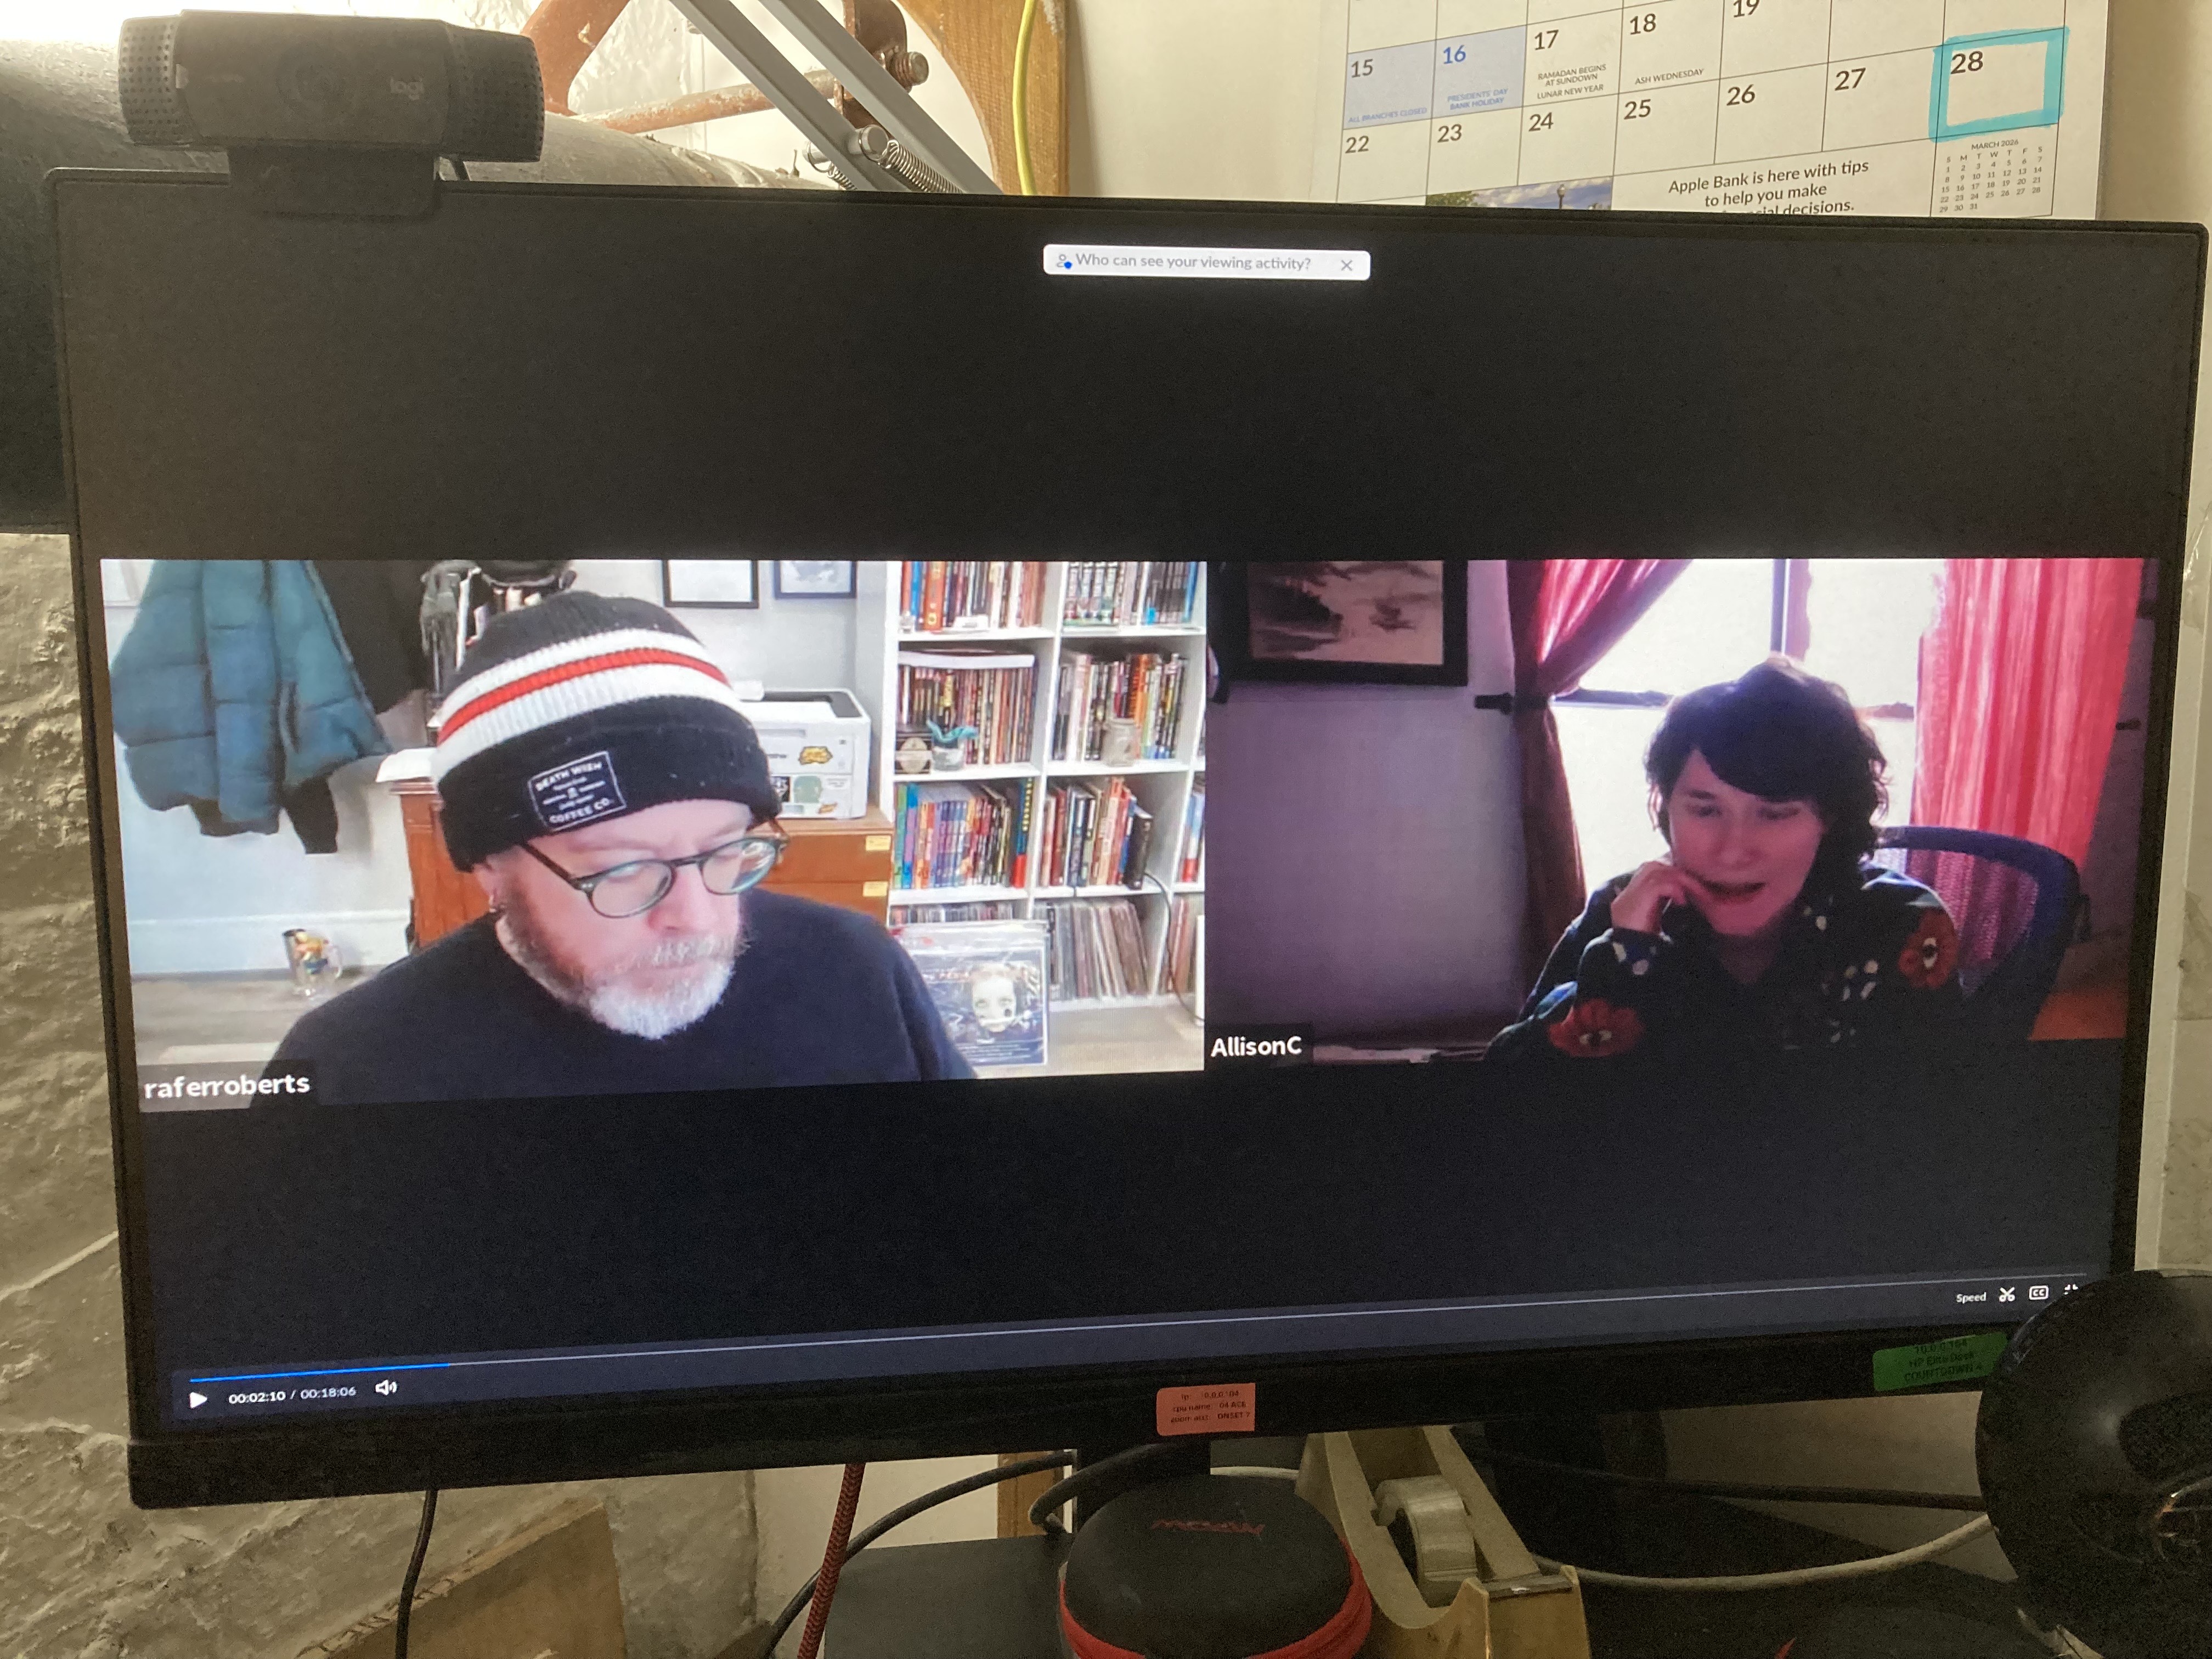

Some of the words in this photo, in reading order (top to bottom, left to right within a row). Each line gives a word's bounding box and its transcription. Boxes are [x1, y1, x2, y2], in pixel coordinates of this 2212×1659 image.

[1733, 0, 1759, 18] 19
[1630, 13, 1656, 35] 18
[1534, 30, 1559, 50] 17
[1443, 45, 1466, 64] 16
[1950, 51, 1983, 74] 28
[1351, 59, 1373, 78] 15
[1538, 69, 1577, 80] RAMADAN
[1579, 64, 1606, 75] BEGINS
[1635, 76, 1651, 84] ASH
[1653, 68, 1705, 82] WEDNESDAY
[1556, 74, 1598, 85] SUNDOWN
[1835, 68, 1866, 91] 27
[1493, 88, 1508, 96] DAY
[1537, 89, 1562, 99] LUNAR
[1584, 84, 1604, 93] YEAR
[1726, 84, 1755, 106] 26
[1400, 107, 1426, 116] CLOSED
[1450, 101, 1470, 110] BANK
[1472, 97, 1504, 107] HOLIDAY
[1624, 99, 1651, 119] 25
[1528, 112, 1554, 132] 24
[1437, 124, 1462, 143] 23
[1345, 136, 1369, 153] 22
[1972, 141, 1999, 150] MARCH
[1668, 178, 1709, 195] Apple
[1714, 173, 1748, 189] Bank
[1753, 171, 1763, 184] is
[1768, 170, 1800, 183] here
[1804, 163, 1836, 178] with
[1842, 160, 1869, 176] tips
[1705, 195, 1719, 207] to
[1723, 190, 1753, 206] help
[1758, 190, 1783, 204] you
[1788, 184, 1827, 199] make
[1784, 200, 1854, 215] decisions.
[1075, 253, 1109, 266] Who
[1113, 256, 1136, 267] can
[1141, 257, 1164, 267] see
[1166, 258, 1197, 269] your
[1201, 256, 1252, 270] viewing
[1256, 257, 1311, 271] activity?
[1211, 1036, 1302, 1057] AllisonC
[144, 1074, 311, 1099] raferroberts
[1956, 1291, 1987, 1304] Speed
[229, 1391, 286, 1404] 00:02:10
[290, 1390, 296, 1401] /
[300, 1387, 357, 1401] 00:18:06
